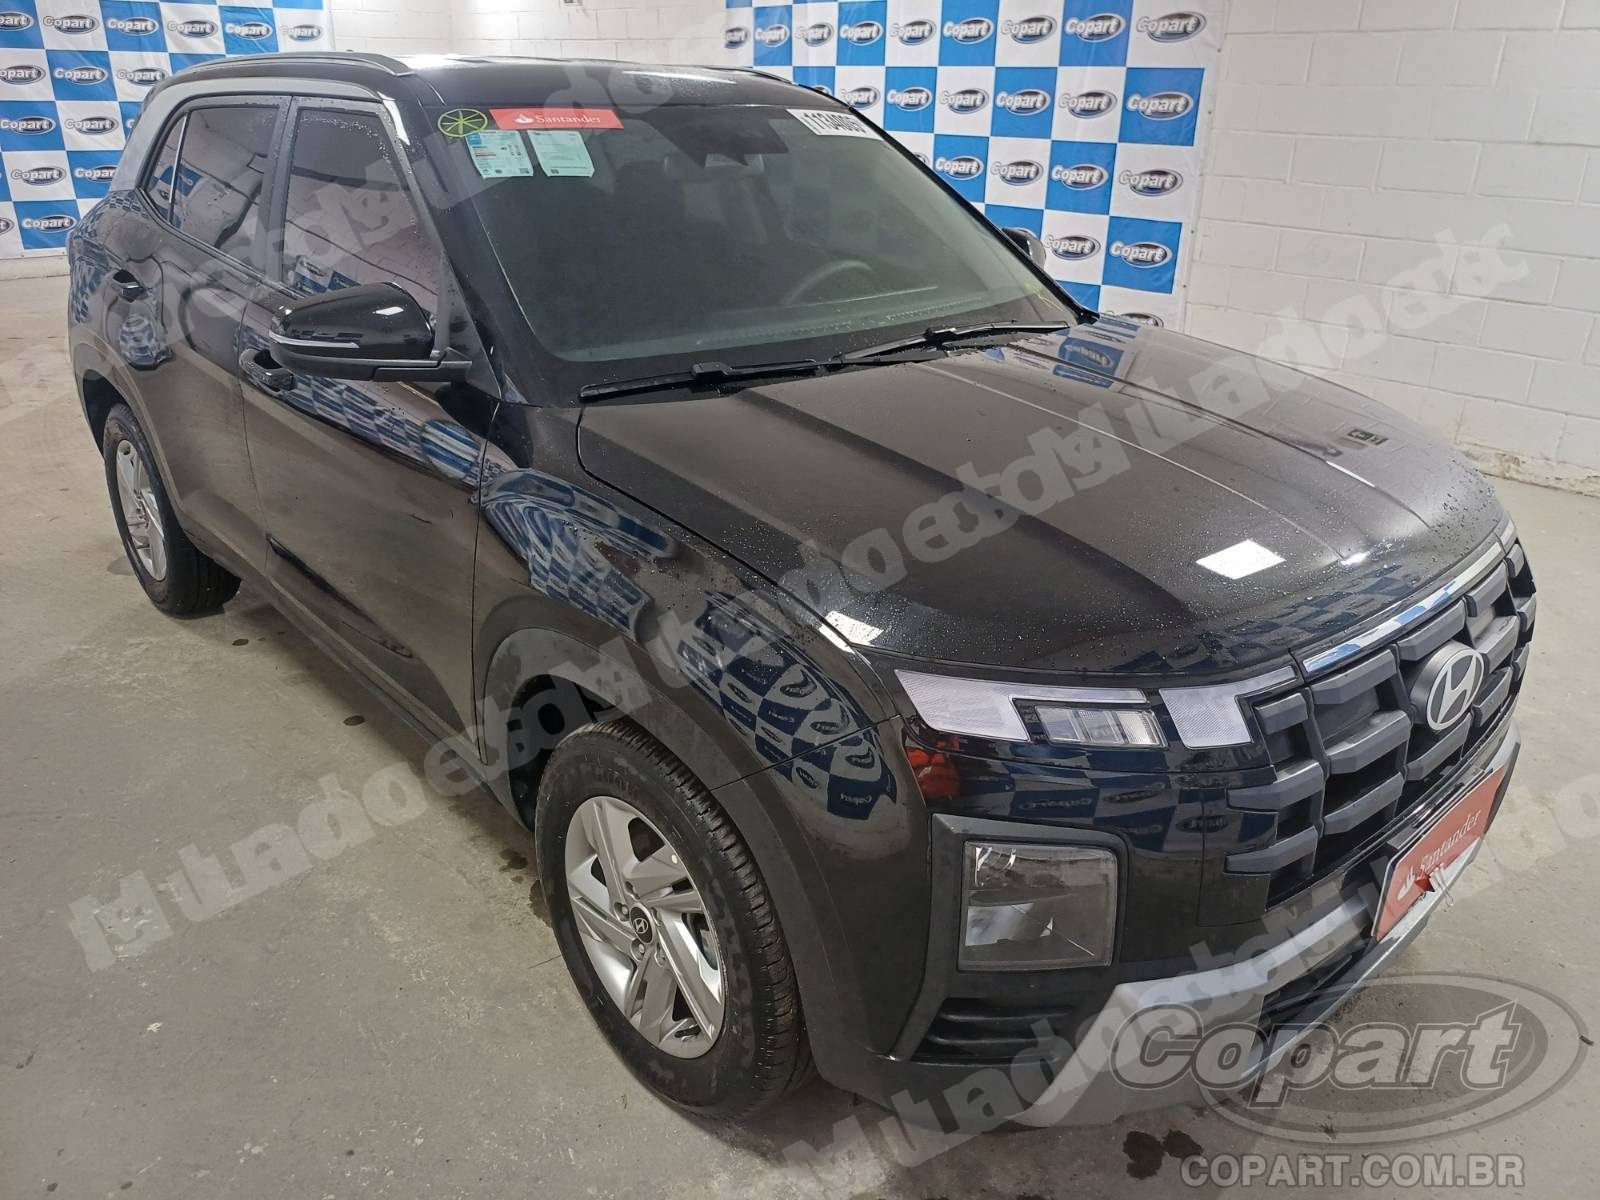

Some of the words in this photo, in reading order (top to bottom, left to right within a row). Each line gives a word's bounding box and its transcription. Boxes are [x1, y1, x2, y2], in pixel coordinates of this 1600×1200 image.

[43, 15, 92, 33] Copart
[107, 17, 152, 33] Copart
[168, 20, 211, 36] Copart
[225, 22, 267, 37] Copart
[840, 24, 878, 40] Copart
[890, 23, 932, 40] Copart
[943, 21, 988, 40] Copart
[1001, 18, 1049, 38] Copart
[1065, 17, 1116, 36] Copart
[1137, 15, 1193, 35] Copart
[755, 28, 785, 43] Copart
[794, 26, 830, 41] Copart
[54, 67, 102, 84] Copart
[840, 88, 877, 105] Copart
[887, 88, 929, 106] Copart
[940, 89, 983, 107] Copart
[995, 91, 1047, 109] Copart
[1059, 92, 1110, 111] Copart
[1127, 93, 1186, 114] Copart
[1, 117, 50, 134] Copart
[65, 117, 114, 133] Copart
[535, 113, 602, 124] Santander
[10, 166, 60, 183] Copart
[935, 156, 979, 175] Copart
[991, 159, 1037, 181] Copart
[1050, 163, 1101, 184] Copart
[1119, 169, 1176, 189] Copart
[22, 217, 70, 234] Copart
[1045, 234, 1091, 256] Copart
[1111, 241, 1164, 263] Copart
[1421, 809, 1482, 872] Santander
